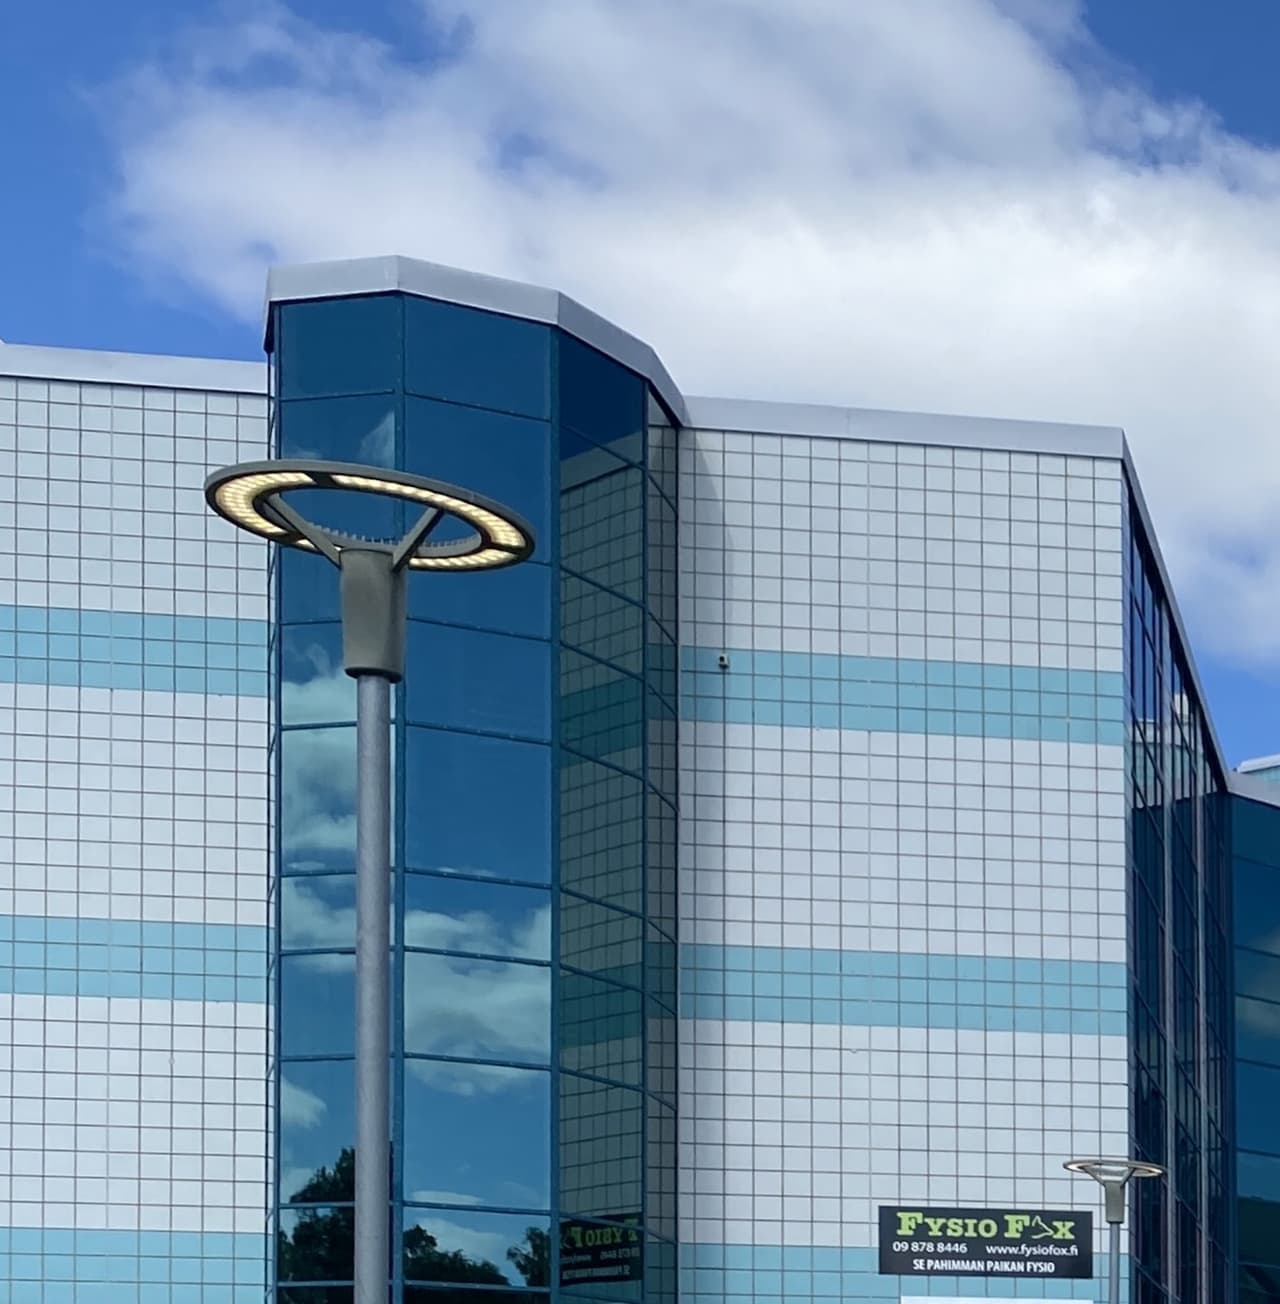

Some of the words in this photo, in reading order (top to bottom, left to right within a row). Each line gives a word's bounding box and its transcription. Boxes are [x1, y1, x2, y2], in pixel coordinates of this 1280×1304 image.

[892, 1241, 909, 1252] 09
[910, 1242, 935, 1253] 878
[936, 1243, 968, 1254] 8446
[985, 1244, 1079, 1257] www.fysiofox.fi
[913, 1259, 925, 1271] SE
[926, 1259, 985, 1272] PAHIMMAN
[986, 1260, 1026, 1273] PAIKAN
[1026, 1261, 1055, 1273] FYSIO
